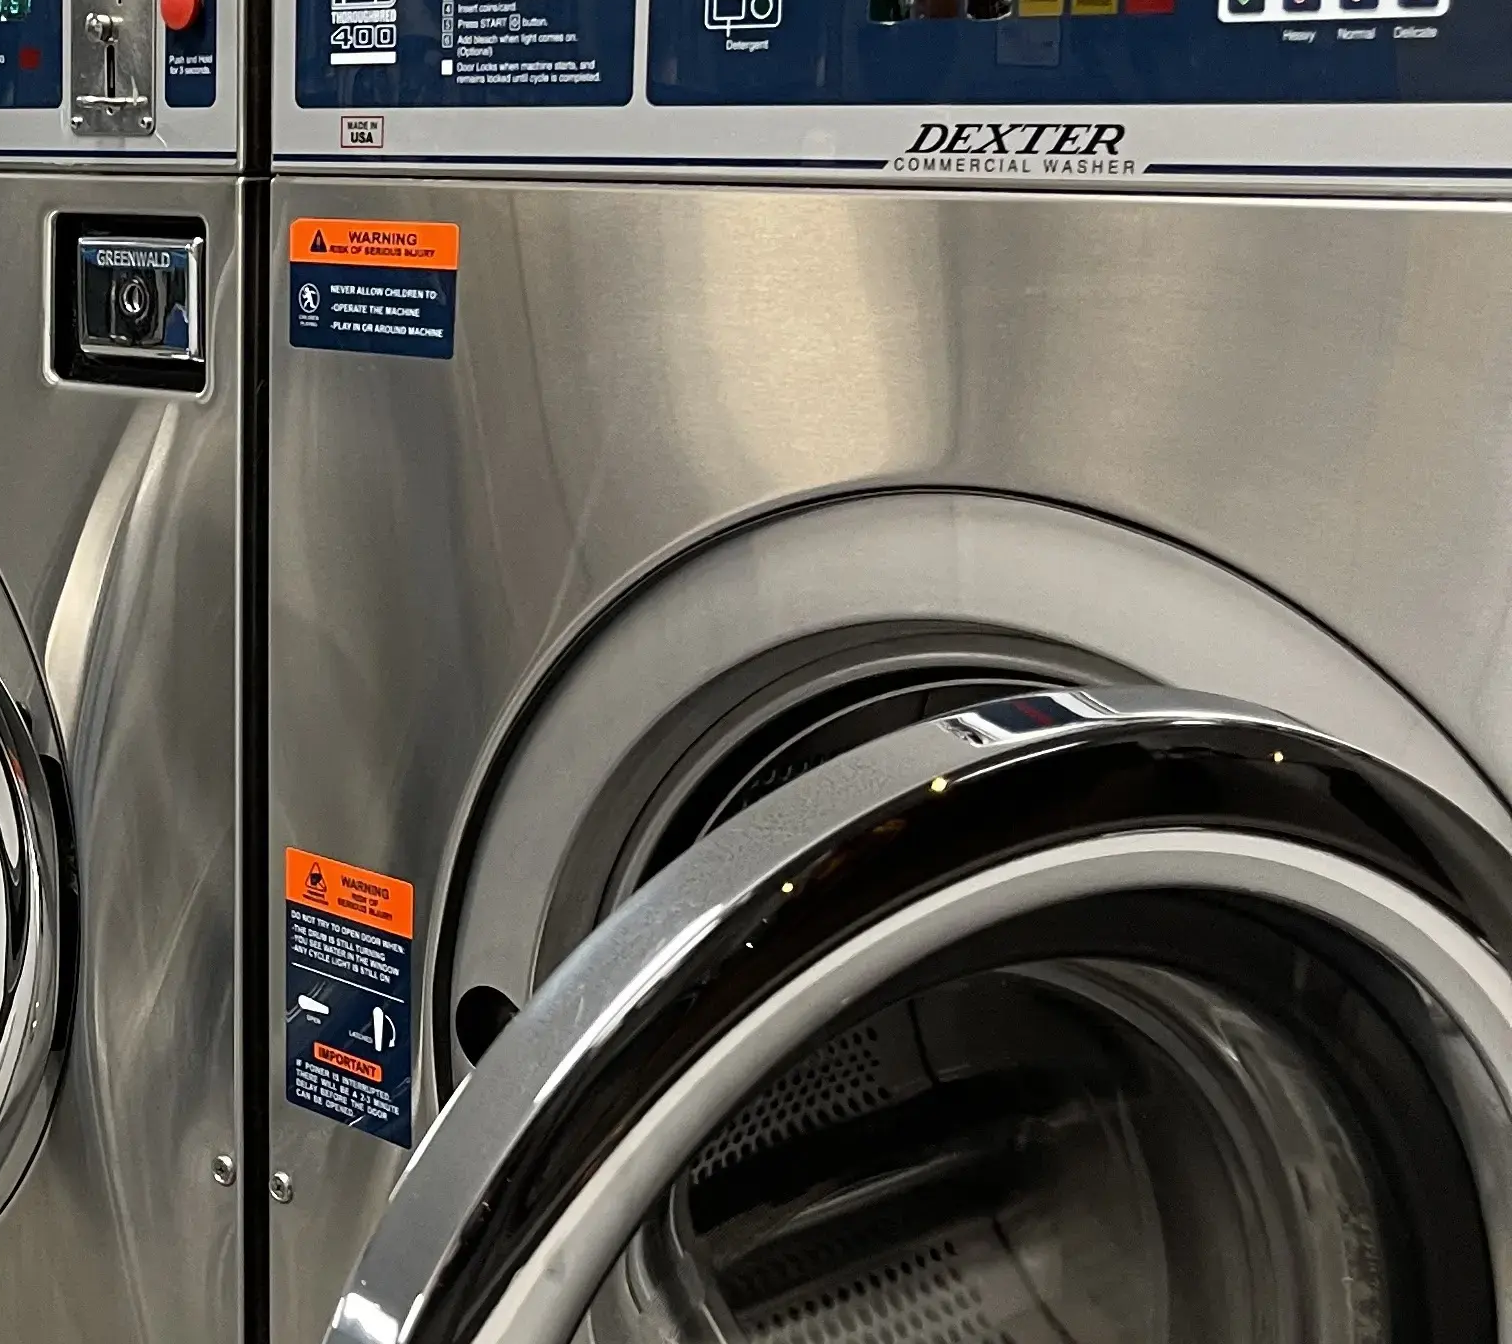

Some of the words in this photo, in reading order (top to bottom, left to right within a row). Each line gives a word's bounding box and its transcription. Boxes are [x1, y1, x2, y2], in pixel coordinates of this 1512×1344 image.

[480, 18, 507, 28] START
[330, 24, 397, 49] 400
[347, 121, 368, 130] MADE
[370, 121, 378, 129] IN
[350, 132, 374, 143] USA
[905, 123, 1125, 156] DEXTER
[894, 157, 1031, 173] COMMERCIAL
[1044, 160, 1135, 175] WASHER
[348, 231, 417, 246] WARNING
[351, 246, 363, 254] OF
[96, 249, 171, 268] GREENWALD
[330, 285, 355, 295] NEVER
[356, 285, 383, 297] ALLOW
[385, 287, 424, 299] CHILDREN
[425, 290, 438, 300] TO
[369, 305, 384, 315] THE
[385, 307, 420, 318] MACHINE
[352, 322, 360, 331] IN
[361, 323, 373, 332] OR
[374, 324, 406, 336] AROUND
[408, 326, 443, 338] MACHINE
[341, 875, 389, 900] WARNING
[291, 910, 301, 920] DO
[302, 914, 316, 924] NOT
[317, 918, 329, 929] TRY
[330, 922, 341, 933] TO
[341, 927, 360, 939] OPEN
[361, 933, 381, 946] DOOR
[308, 949, 330, 963] CYCLE
[305, 1061, 330, 1078] POWER
[318, 1047, 376, 1078] IMPORTANT
[296, 1088, 311, 1100] CAN
